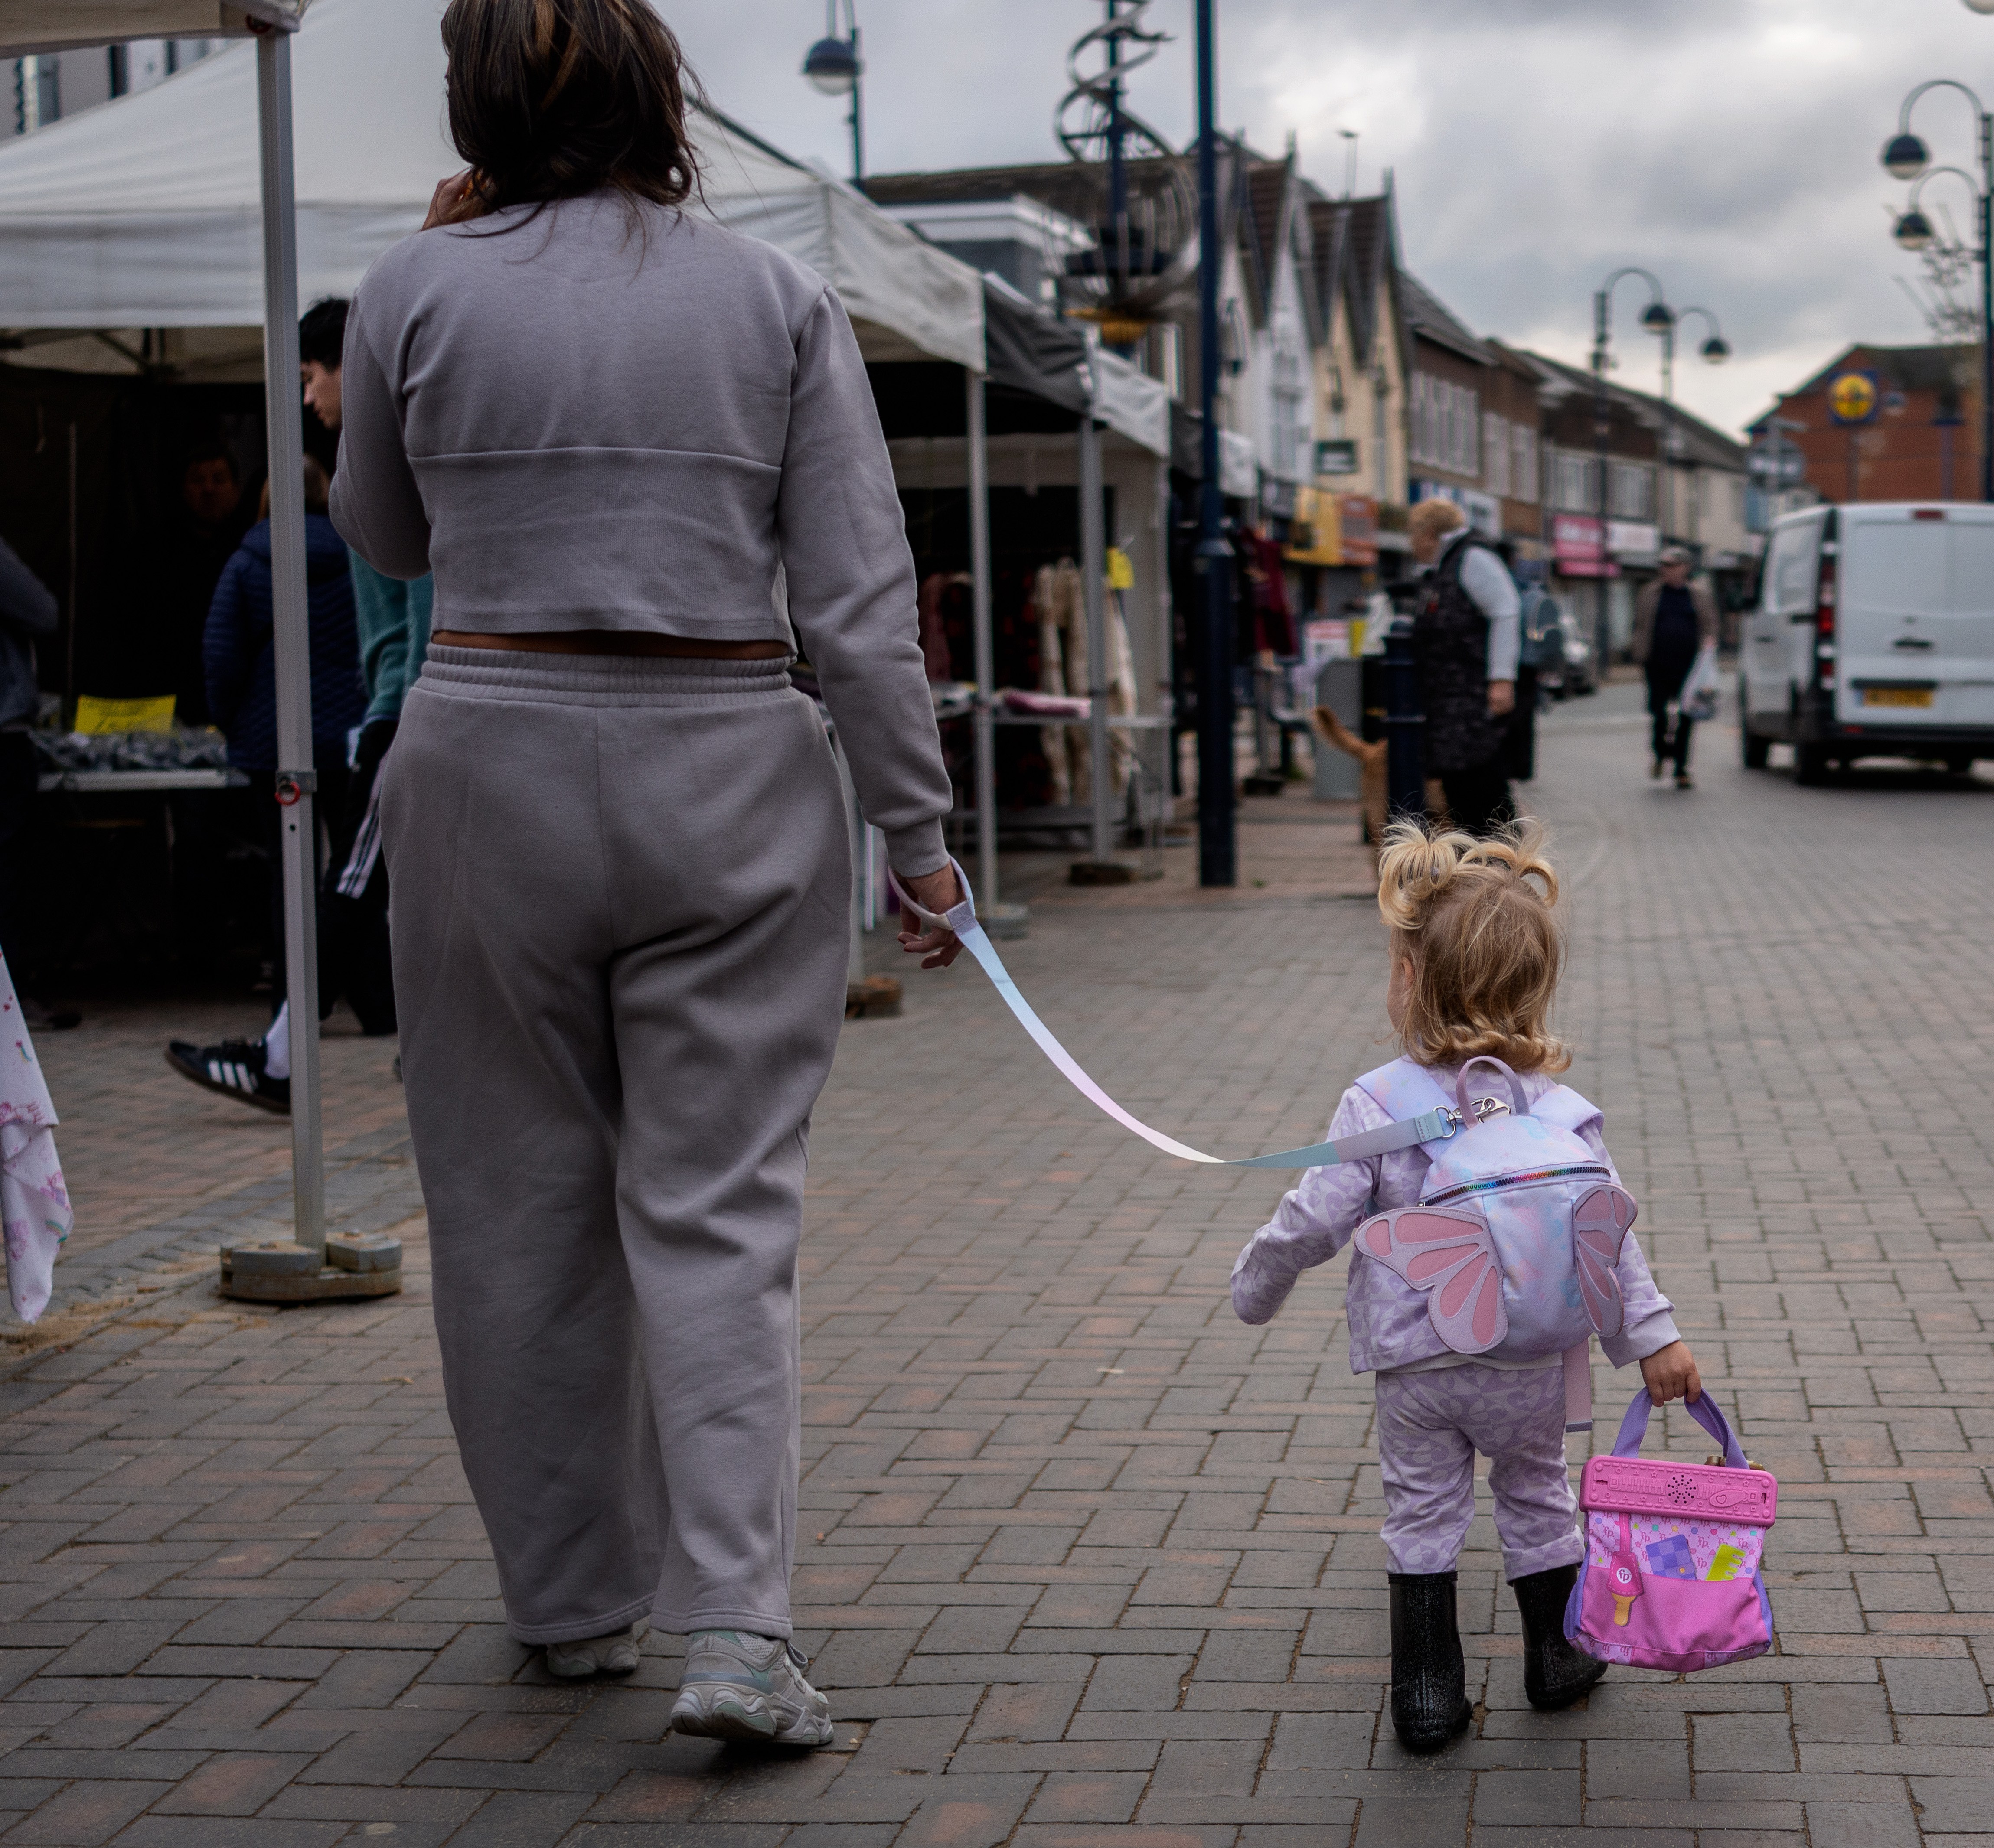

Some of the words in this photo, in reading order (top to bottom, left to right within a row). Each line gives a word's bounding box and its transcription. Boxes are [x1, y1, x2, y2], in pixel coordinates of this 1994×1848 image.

[1604, 1526, 1614, 1538] fp
[1641, 1531, 1651, 1542] fp
[1698, 1536, 1709, 1548] fp
[1738, 1538, 1748, 1549] fp
[1697, 1557, 1707, 1568] fp
[1618, 1569, 1630, 1582] fp
